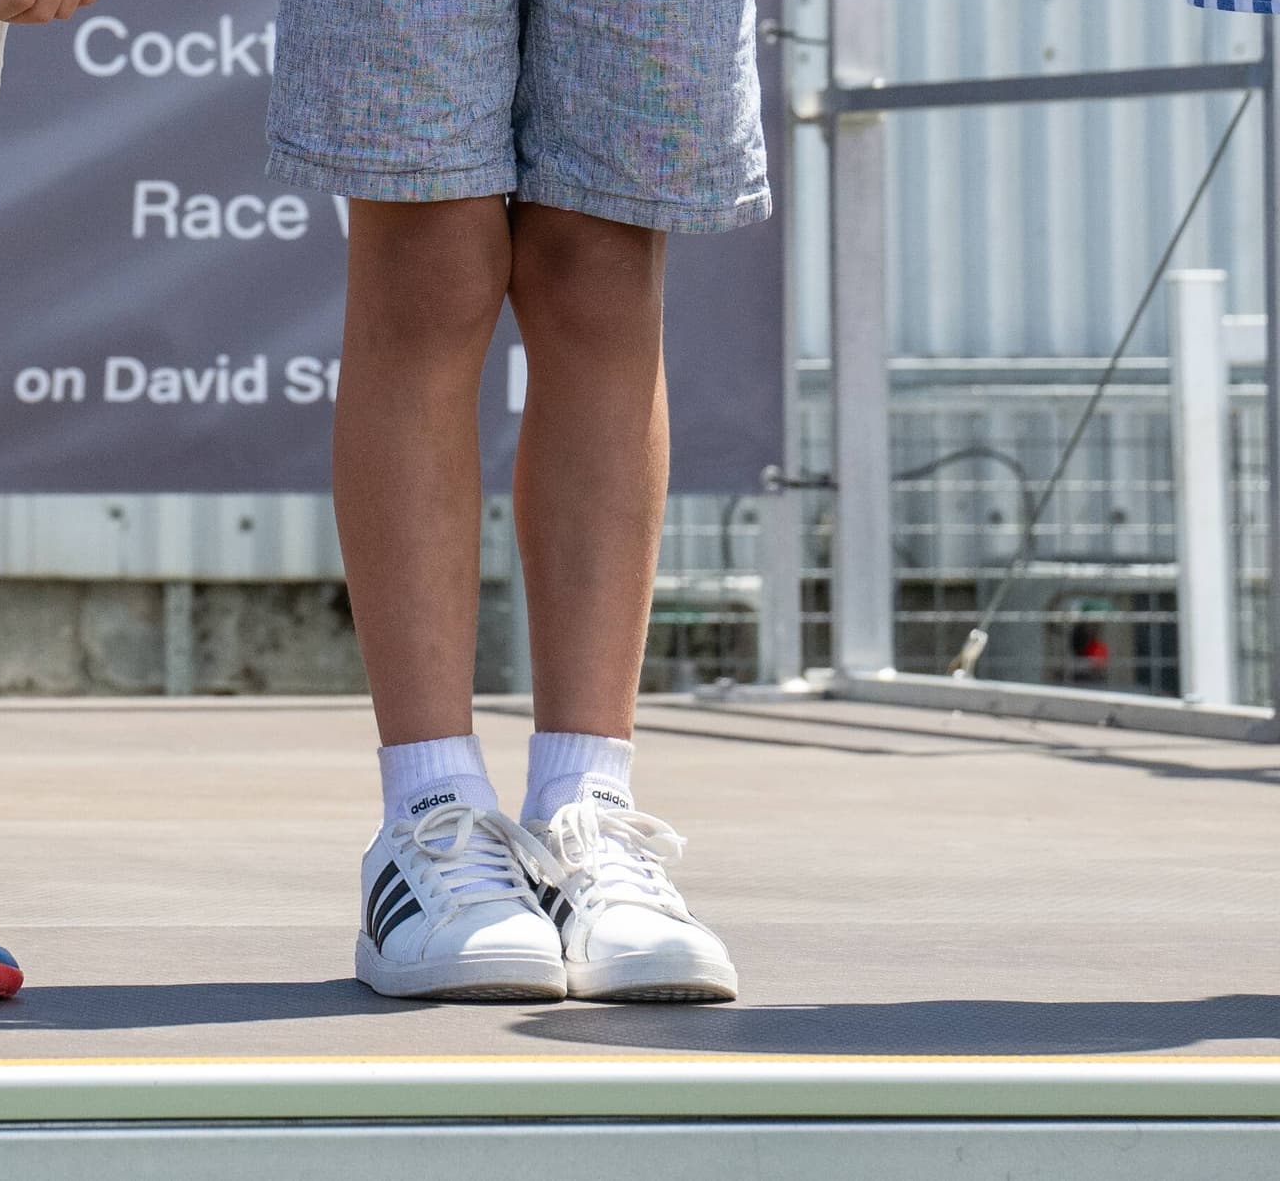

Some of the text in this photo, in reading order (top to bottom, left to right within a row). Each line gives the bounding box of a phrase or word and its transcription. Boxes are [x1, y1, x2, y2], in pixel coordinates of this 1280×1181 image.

[131, 179, 310, 241] Race
[14, 365, 86, 403] on
[104, 355, 268, 403] David
[410, 791, 457, 815] adidas
